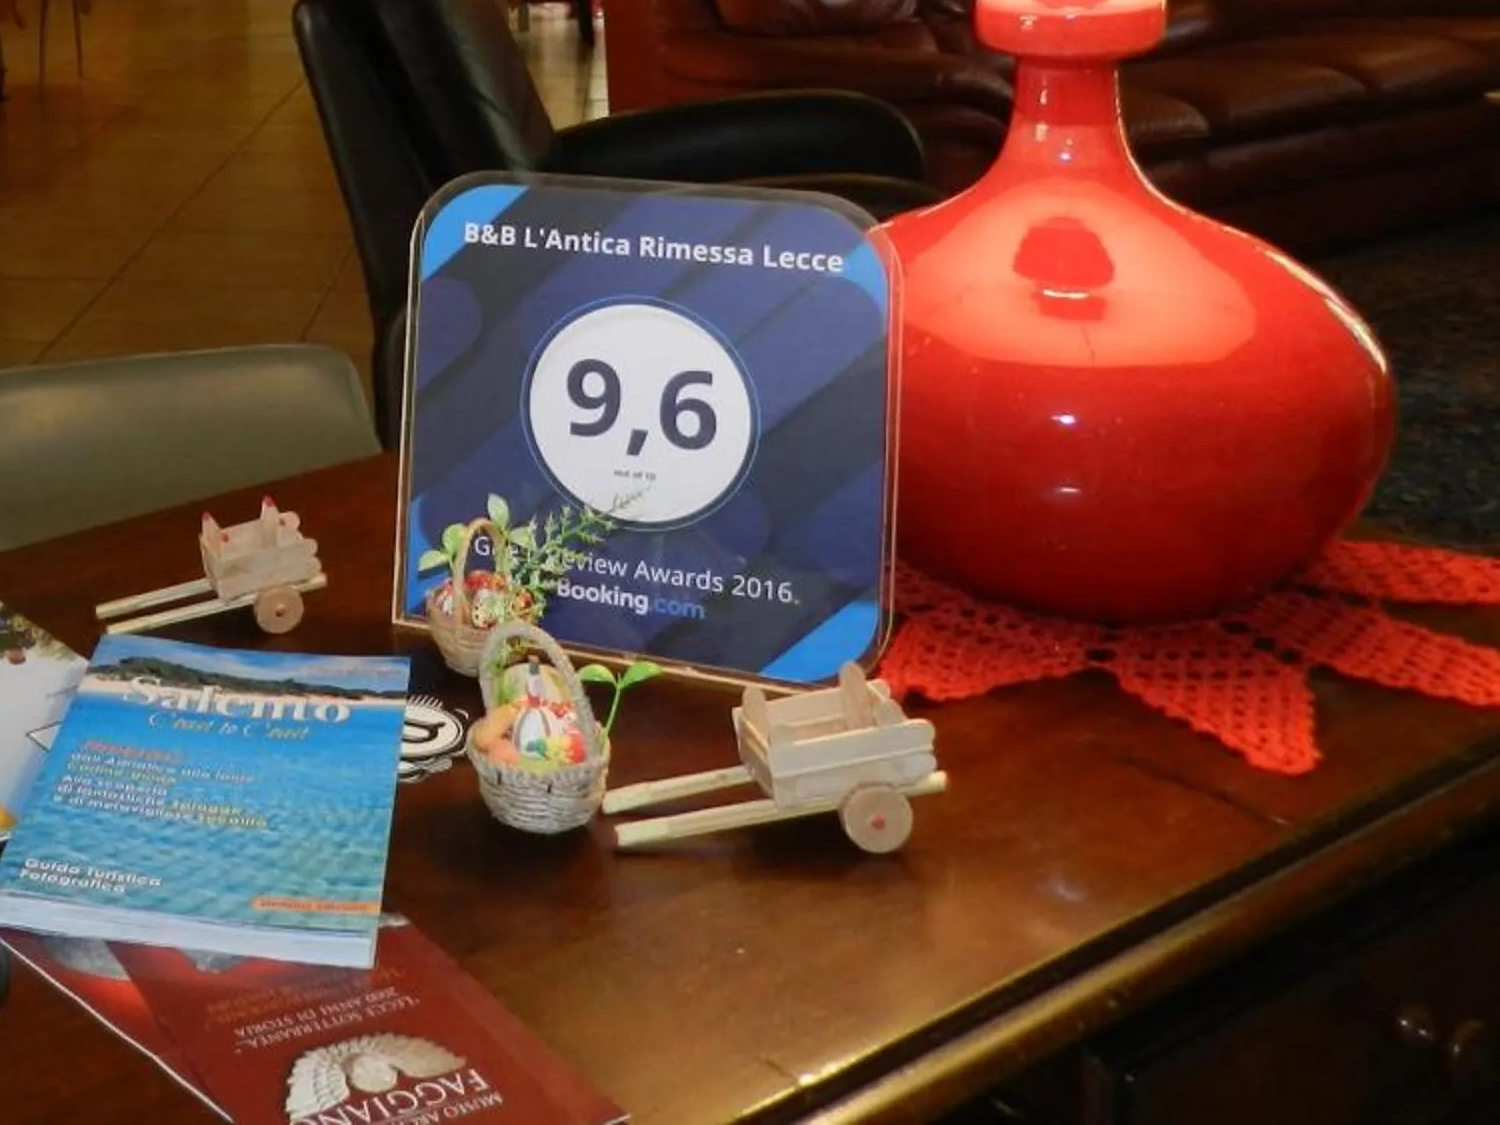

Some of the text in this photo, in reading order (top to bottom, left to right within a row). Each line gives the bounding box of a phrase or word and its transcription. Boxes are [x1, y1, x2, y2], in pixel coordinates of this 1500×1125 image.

[464, 223, 845, 273] B&B L'Antica Rimessa Lecce
[566, 358, 718, 457] 9,6
[545, 544, 628, 578] eview
[634, 560, 723, 593] Awards
[556, 579, 706, 620] Booking.com
[123, 676, 352, 723] Salento
[19, 869, 126, 894] Fotografica
[24, 858, 162, 887] Guida Turistica
